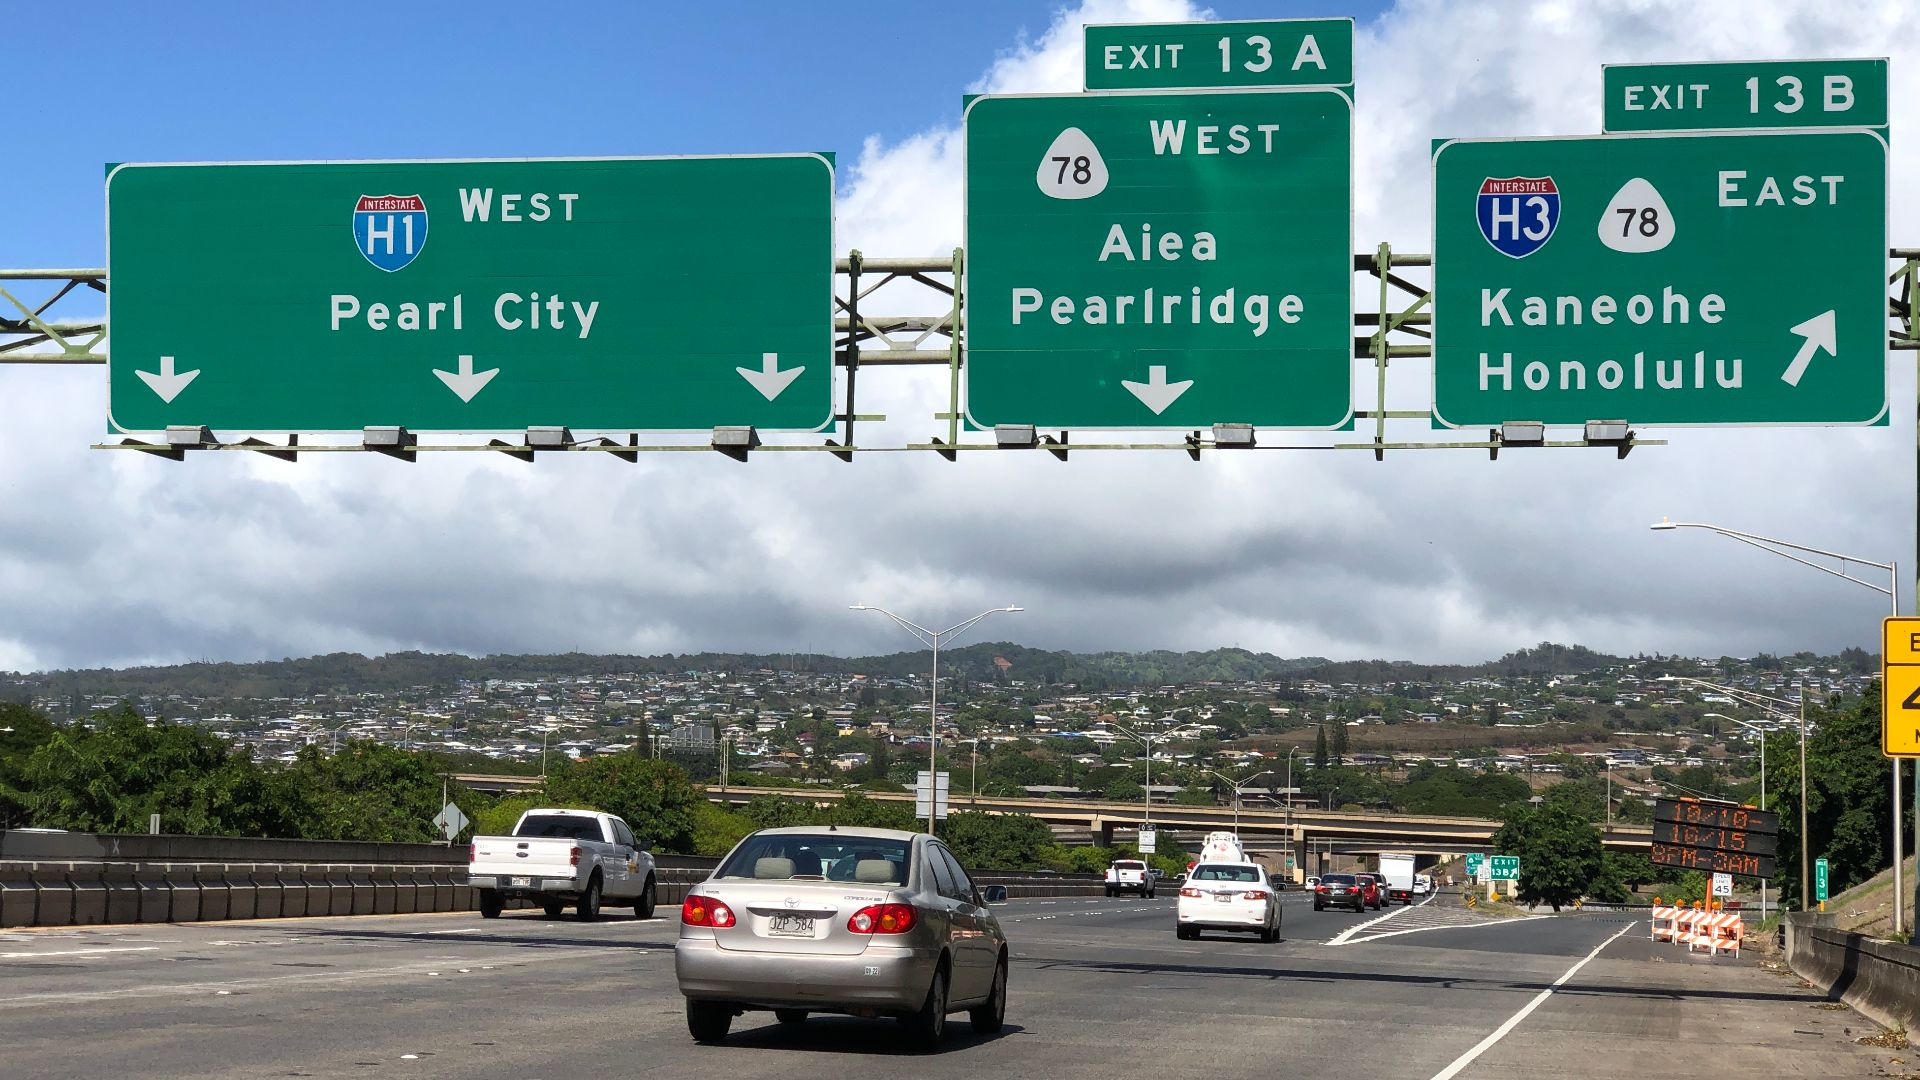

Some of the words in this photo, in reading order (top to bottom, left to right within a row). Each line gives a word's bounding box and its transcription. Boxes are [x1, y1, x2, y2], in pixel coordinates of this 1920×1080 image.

[1104, 44, 1184, 70] EXIT
[1624, 84, 1709, 111] EXIT
[1150, 119, 1280, 155] WEST
[1051, 155, 1092, 185] 78
[1489, 181, 1548, 193] INTERSTATE
[364, 199, 416, 210] INTERSTATE
[459, 188, 579, 222] WEST
[1718, 170, 1844, 207] EAST
[367, 214, 413, 255] H1
[1491, 196, 1551, 242] H3
[1616, 207, 1659, 238] 78
[1098, 223, 1217, 261] Aiea
[330, 293, 463, 331] Pearl
[493, 291, 600, 339] City
[1011, 286, 1304, 337] Pearlridge
[1480, 285, 1726, 327] Kaneohe
[1478, 350, 1743, 391] Honolulu
[1714, 885, 1730, 894] 45
